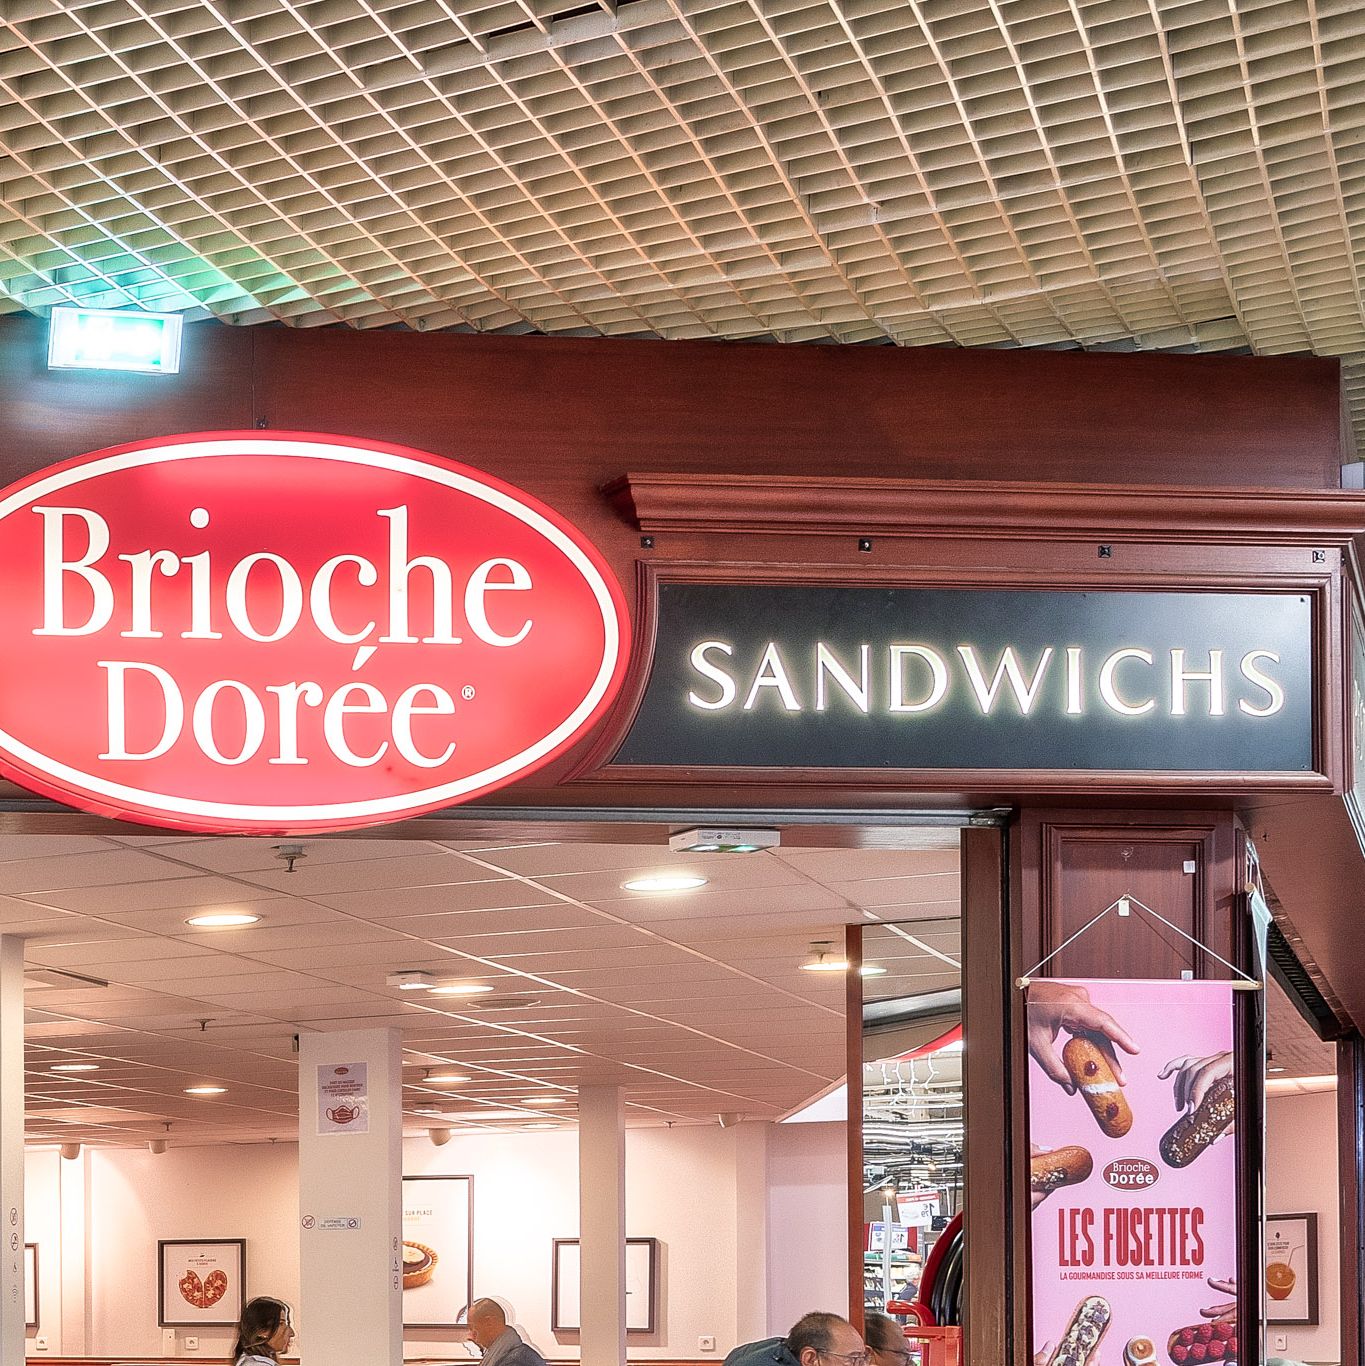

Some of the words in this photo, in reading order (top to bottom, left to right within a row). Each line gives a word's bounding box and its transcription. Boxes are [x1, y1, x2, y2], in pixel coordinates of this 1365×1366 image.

[32, 505, 533, 647] Brioche
[689, 641, 1284, 716] SANDWICHS
[1108, 1171, 1155, 1185] Dorée
[1112, 1161, 1151, 1172] Brioche
[1058, 1206, 1095, 1267] LES
[1103, 1206, 1205, 1267] FUSETTES
[1059, 1273, 1069, 1281] LA
[1068, 1271, 1116, 1281] GOURMANDISE
[1116, 1271, 1135, 1280] SOUS
[1135, 1271, 1145, 1280] SA
[1145, 1271, 1181, 1280] MEILLEURE
[1181, 1270, 1204, 1280] FORME
